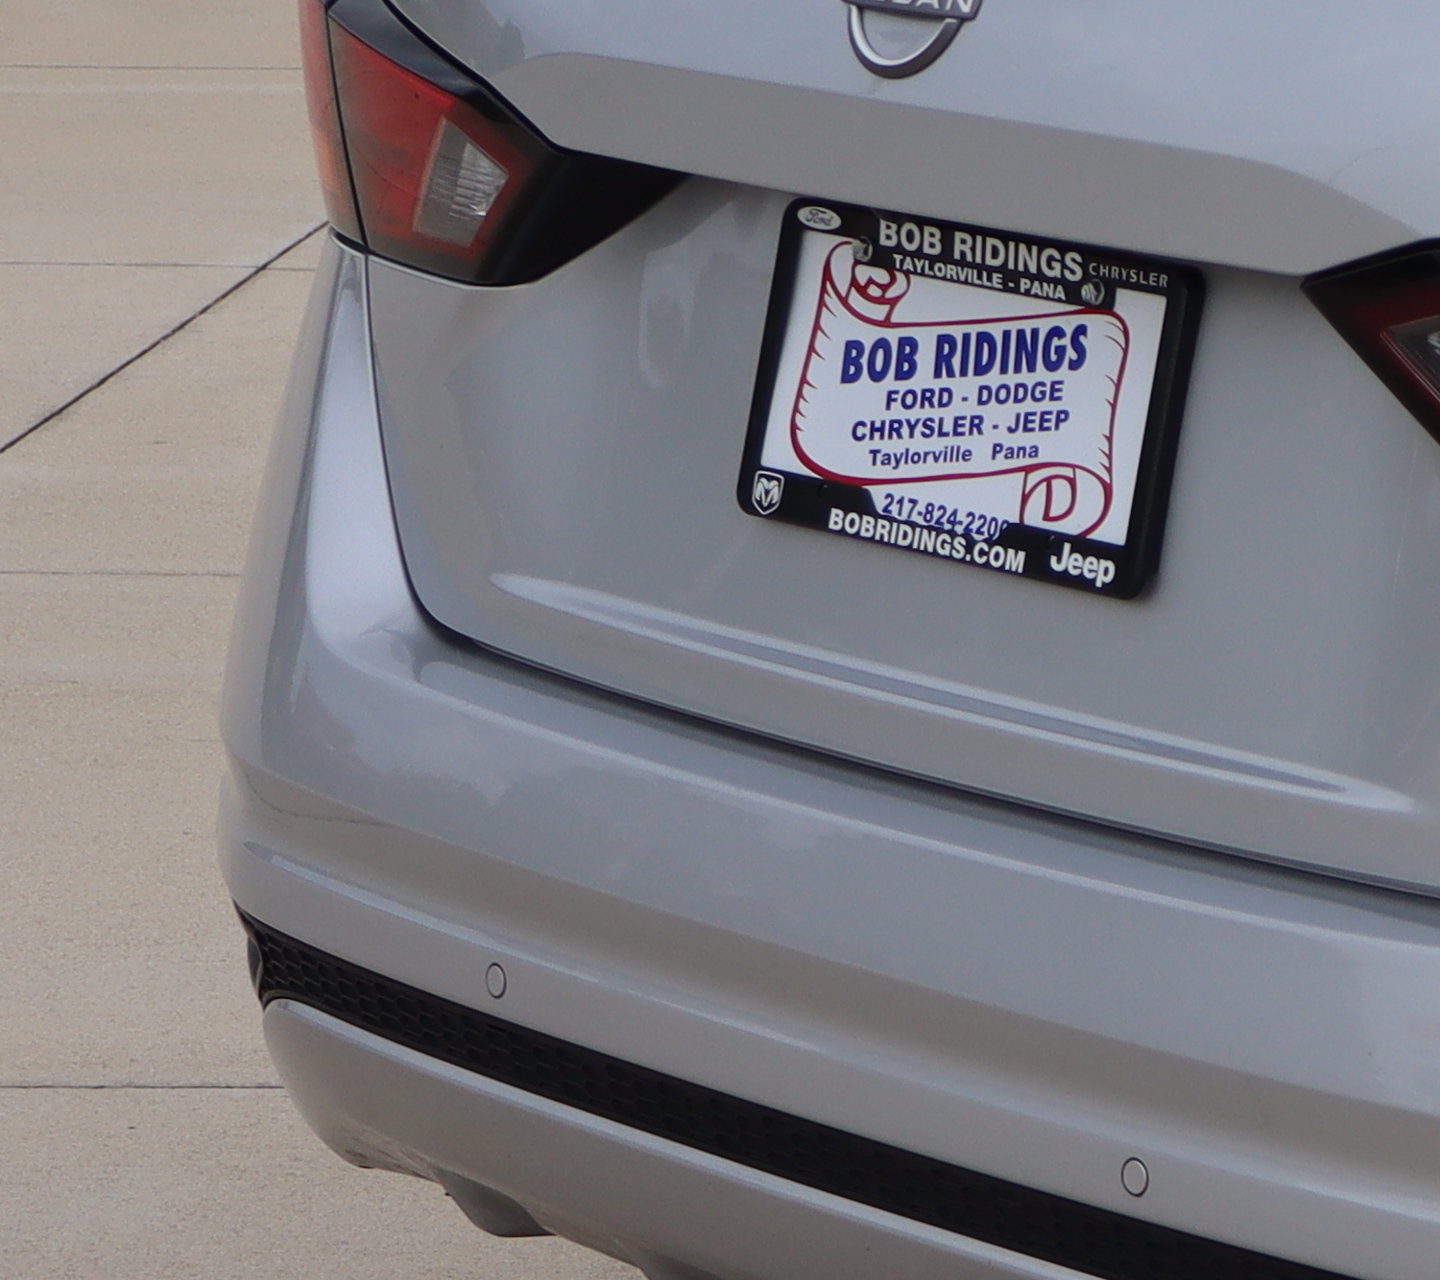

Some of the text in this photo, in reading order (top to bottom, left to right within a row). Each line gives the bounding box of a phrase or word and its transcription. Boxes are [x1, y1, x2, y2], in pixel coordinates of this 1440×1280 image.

[879, 219, 1083, 282] BOB RIDINGS
[892, 254, 1003, 289] TAYLORVILLE
[1020, 278, 1066, 301] PANA
[1089, 262, 1169, 288] CHRYSLER
[840, 323, 1088, 384] BOB RIDINGS
[885, 387, 954, 411] FORD
[976, 380, 1065, 406] DODGE
[851, 415, 984, 442] CHRYSLER
[1006, 409, 1070, 434] JEEP
[869, 442, 1039, 469] Taylorville Pana
[828, 508, 1026, 574] BOBRIDINGS.COM
[1050, 542, 1116, 588] Jeep
